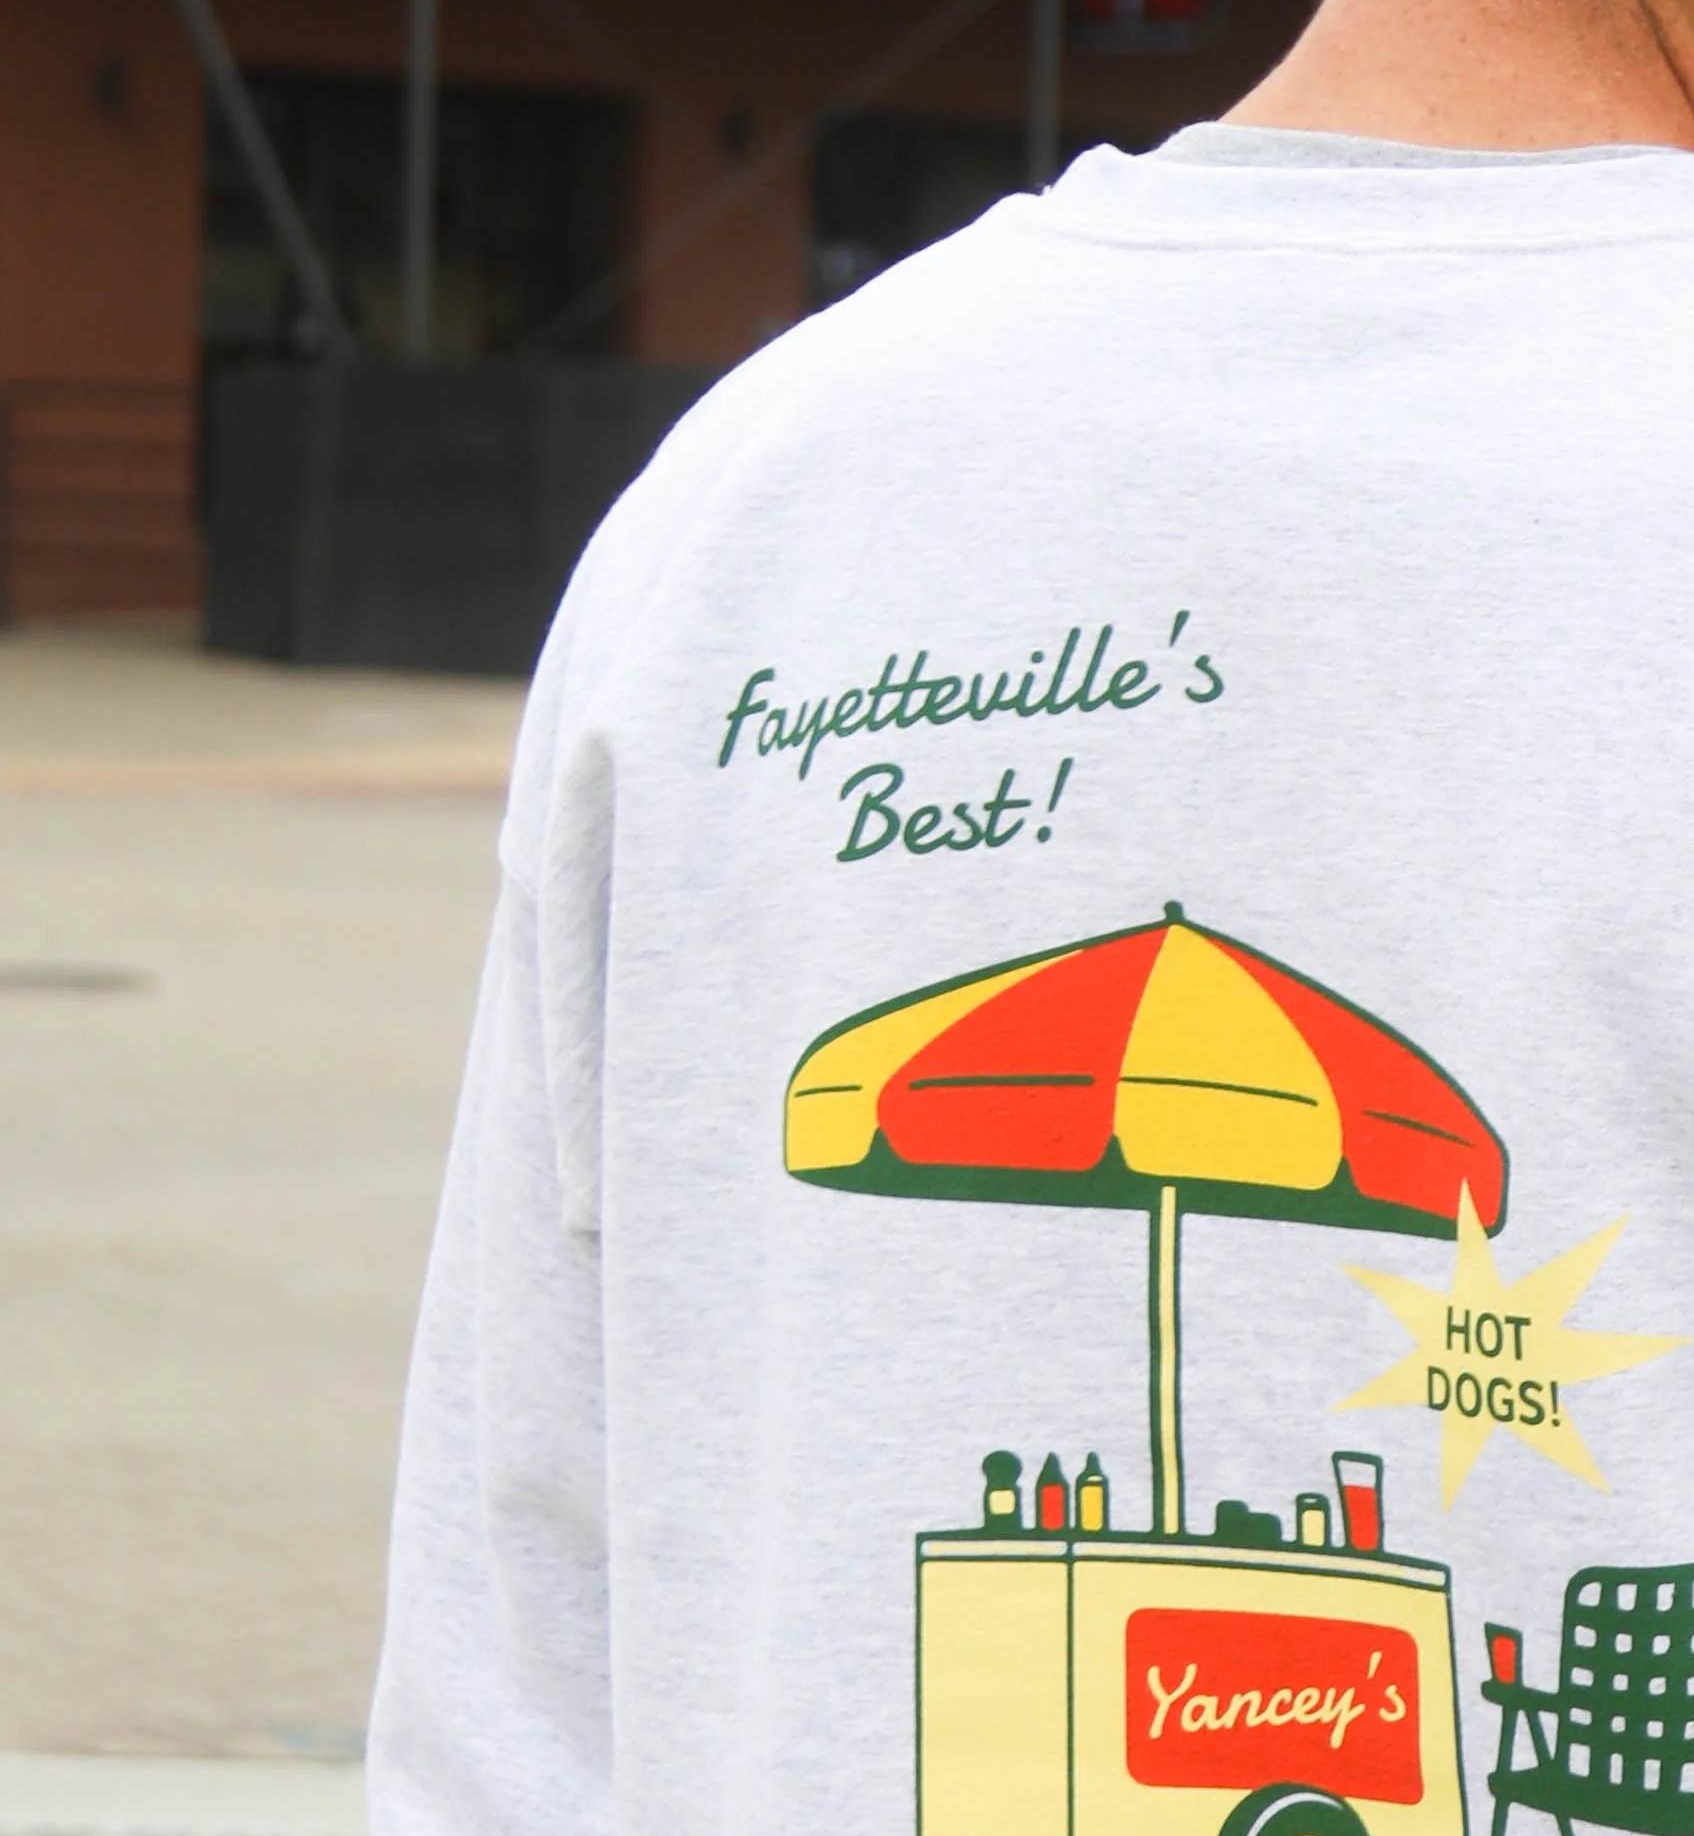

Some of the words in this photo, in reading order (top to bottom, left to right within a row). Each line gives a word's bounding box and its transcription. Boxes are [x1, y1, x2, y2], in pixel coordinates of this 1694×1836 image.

[717, 609, 1225, 782] Fayetteville's
[835, 756, 1075, 864] Best!
[1445, 1305, 1532, 1362] HOT
[1426, 1364, 1561, 1428] DOGS!
[1146, 1650, 1407, 1750] Yancey's
